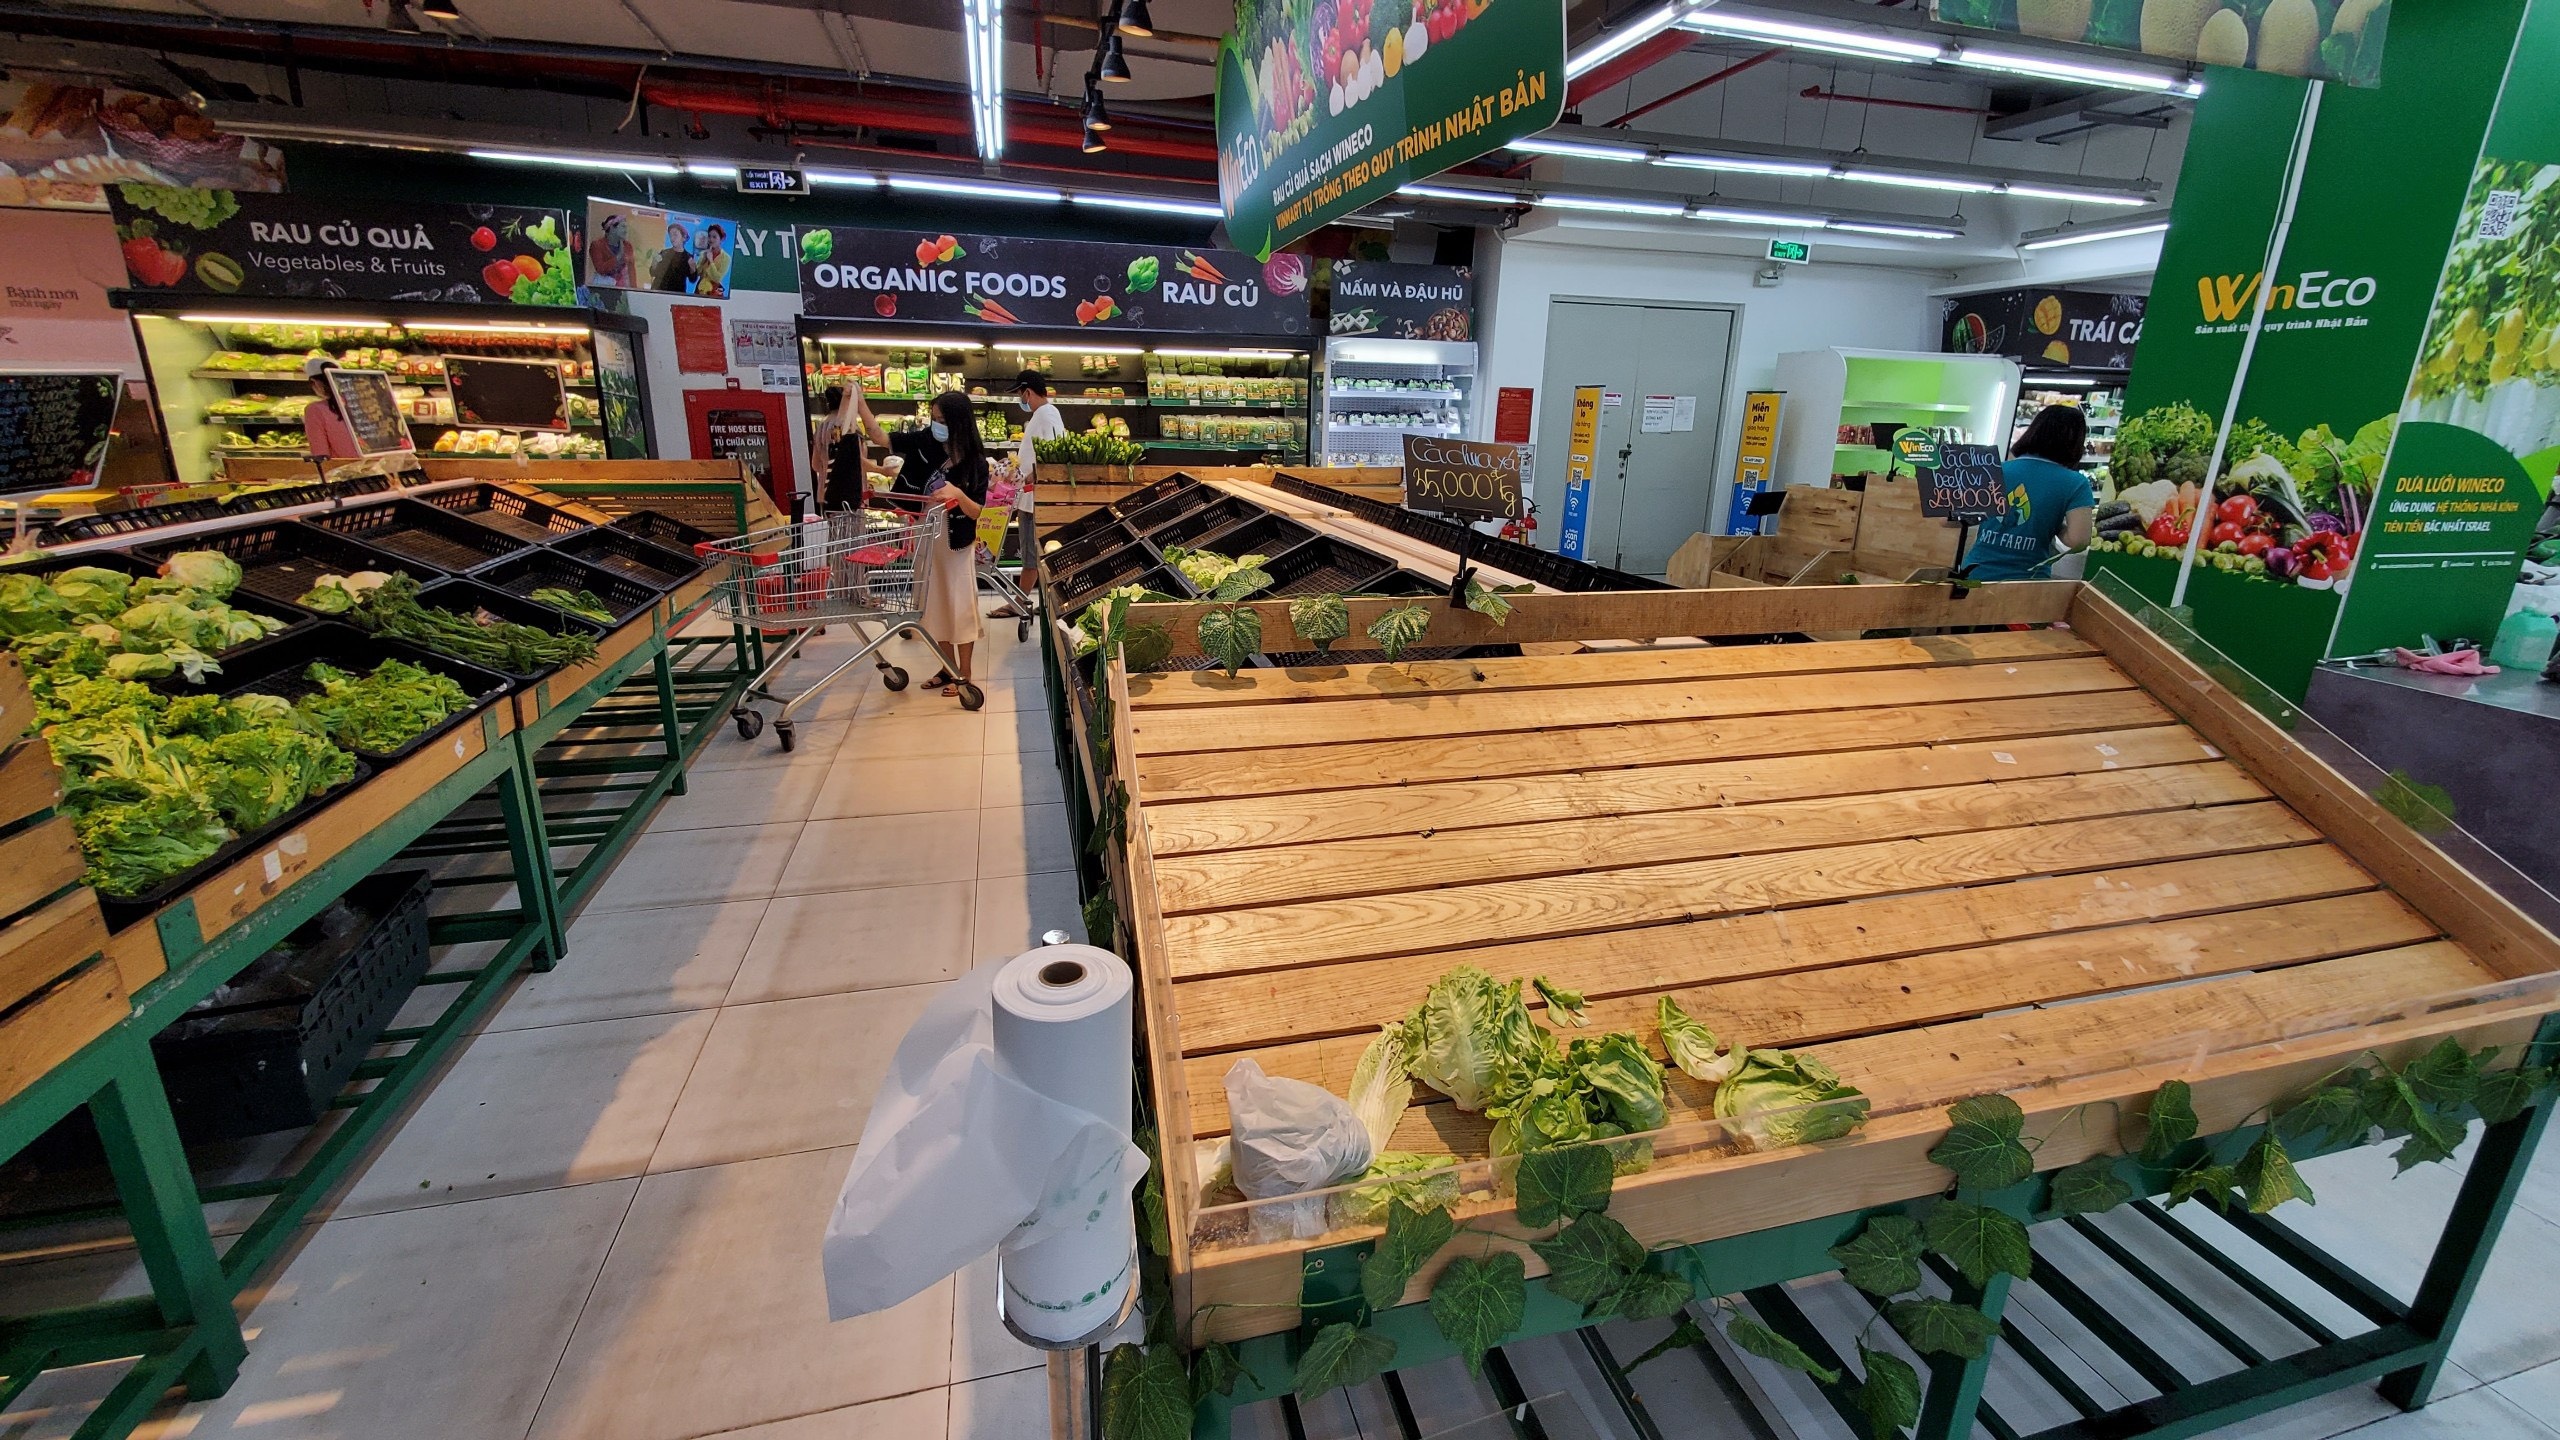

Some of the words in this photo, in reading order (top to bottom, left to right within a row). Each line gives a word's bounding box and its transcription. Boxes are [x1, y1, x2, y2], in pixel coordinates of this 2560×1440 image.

[1275, 200, 1303, 231] VINMART
[1302, 190, 1314, 217] TỰ
[1312, 175, 1343, 210] TRỒNG
[1342, 161, 1370, 193] THEO
[1371, 144, 1395, 178] QUY
[1397, 121, 1442, 165] TRÌNH
[1445, 94, 1495, 143] NHẬT
[1499, 69, 1546, 118] BẢN
[1272, 185, 1285, 207] RAU
[1285, 169, 1295, 198] CỦ
[1294, 158, 1311, 192] QUẢ
[1309, 149, 1333, 183] SẠCH
[1332, 123, 1373, 166] WINECO
[749, 181, 769, 189] EXIT
[1220, 131, 1259, 220] WinEco
[250, 221, 312, 245] RAU
[319, 219, 360, 247] CỦ
[367, 223, 435, 250] QUẢ
[248, 251, 366, 274] Vegetables
[370, 256, 387, 273] &
[391, 257, 446, 276] Fruits
[813, 263, 959, 294] ORGANIC
[965, 271, 1067, 299] FOODS
[1340, 277, 1377, 298] NẤM
[1380, 282, 1402, 299] VÀ
[1404, 283, 1438, 302] ĐẬU
[1445, 281, 1463, 301] HŨ
[1161, 281, 1216, 305] RAU
[1223, 278, 1259, 308] CỦ
[2069, 314, 2116, 343] TRÁI
[2194, 325, 2214, 335] Sản
[2215, 322, 2238, 334] xuất
[2264, 321, 2285, 333] quy
[2285, 320, 2313, 331] trình
[2315, 318, 2343, 330] Nhật
[2344, 315, 2369, 328] Bản
[1751, 401, 1770, 413] Miễn
[1752, 413, 1766, 424] phí
[710, 425, 727, 433] FIRE
[728, 425, 747, 433] HOSE
[748, 425, 767, 433] REEL
[714, 435, 724, 446] TỦ
[725, 436, 746, 446] CHỮA
[746, 437, 766, 447] CHÁY
[1899, 441, 1935, 454] WinEco
[743, 451, 757, 460] 114
[2395, 476, 2424, 493] DƯA
[2425, 474, 2457, 494] LƯỚI
[2457, 478, 2506, 493] WINECO
[2389, 499, 2410, 513] ỨNG
[2409, 502, 2436, 515] DỤNG
[2436, 499, 2449, 515] HỆ
[2450, 499, 2480, 513] THỐNG
[2480, 499, 2497, 513] NHÀ
[2497, 499, 2520, 513] KÍNH
[1564, 529, 1579, 541] Scan
[2383, 520, 2403, 533] TIÊN
[2423, 520, 2440, 534] BẬC
[2440, 518, 2467, 532] NHẤT
[2464, 521, 2492, 533] ISRAEL
[2000, 533, 2037, 551] FARM
